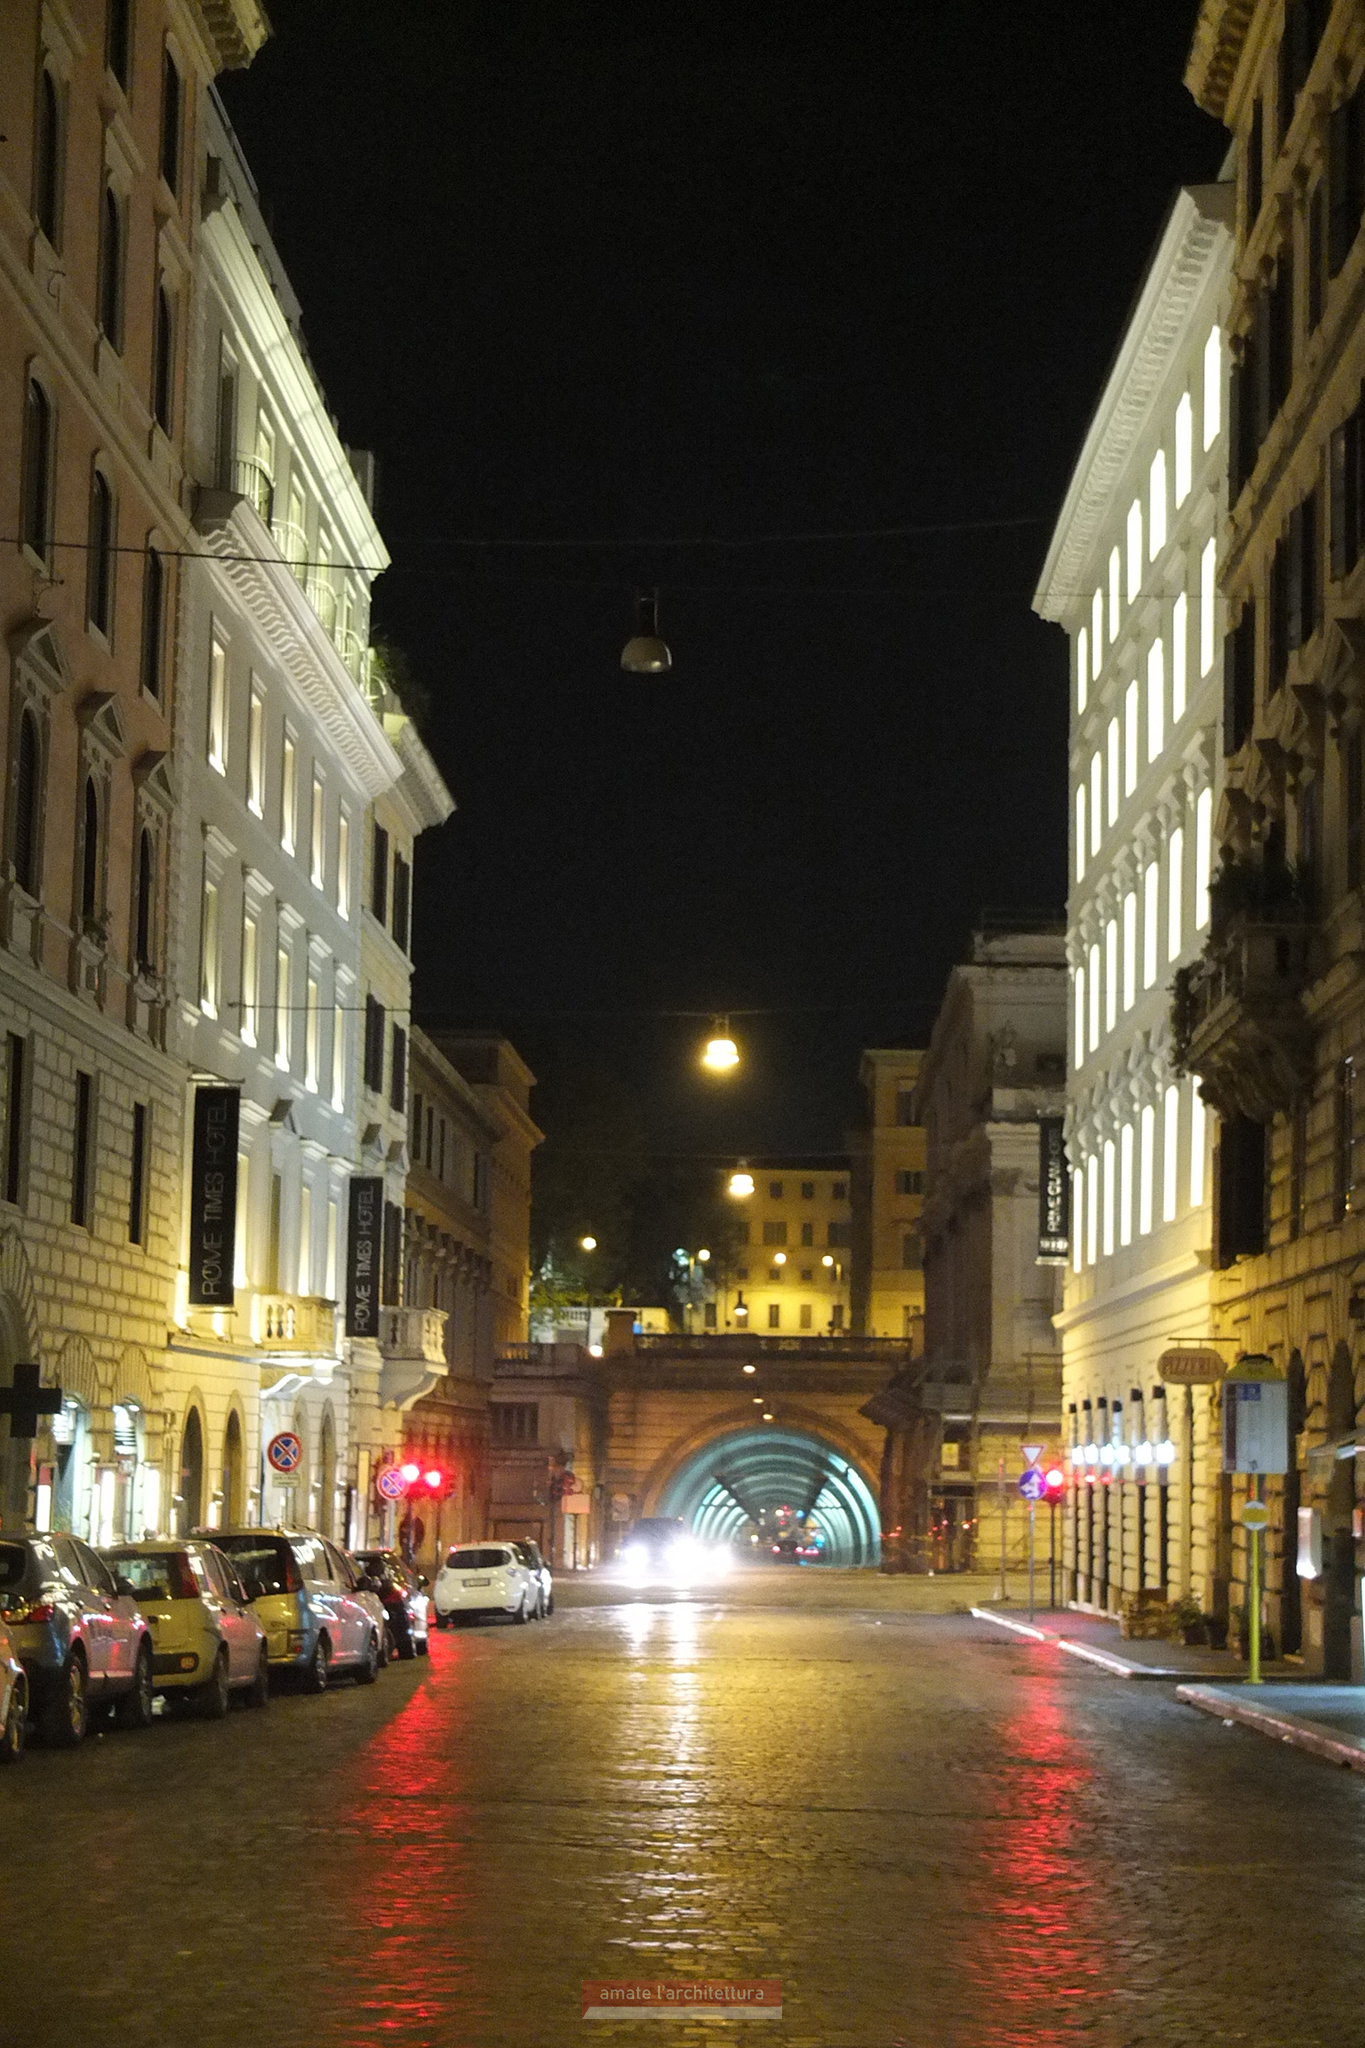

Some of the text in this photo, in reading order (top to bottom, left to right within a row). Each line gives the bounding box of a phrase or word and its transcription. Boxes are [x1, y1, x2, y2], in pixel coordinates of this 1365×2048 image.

[201, 1098, 228, 1296] ROME TIMES HOTEL
[354, 1186, 374, 1331] ROME TIMES HOTEL
